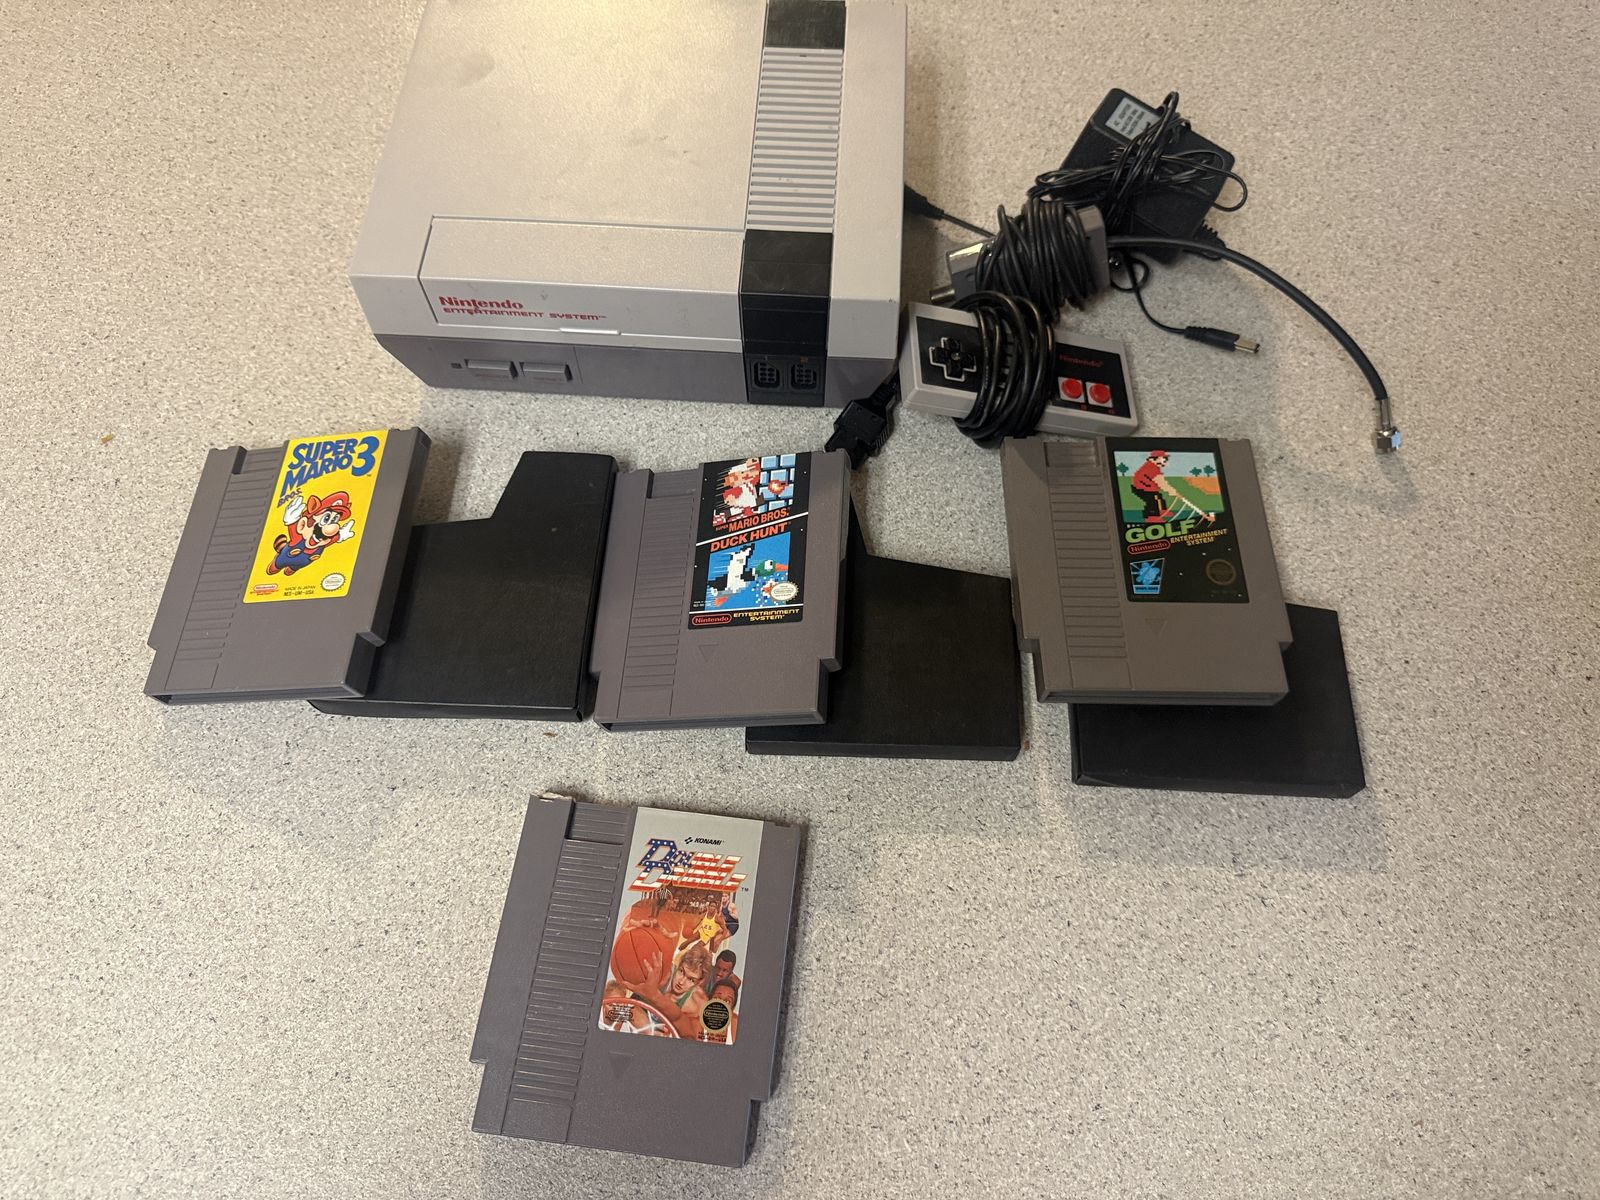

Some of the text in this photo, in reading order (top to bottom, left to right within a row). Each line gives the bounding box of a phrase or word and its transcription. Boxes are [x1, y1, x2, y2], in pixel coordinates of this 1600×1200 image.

[438, 296, 523, 311] Nintendo
[443, 307, 544, 318] ENTERTAINMENT
[288, 438, 358, 469] SUPER
[351, 436, 380, 476] 3
[280, 454, 353, 497] MARIO
[728, 515, 759, 532] MARIO
[760, 508, 790, 521] BROS.
[710, 522, 788, 552] DUCK HUNT
[1125, 519, 1195, 544] GOLF
[1170, 528, 1228, 544] ENTERTAINMENT
[1130, 542, 1168, 553] Nintendo
[1186, 537, 1214, 546] SYSTEM
[733, 609, 800, 618] ENTERTAINMENT
[694, 838, 722, 846] KONAMI
